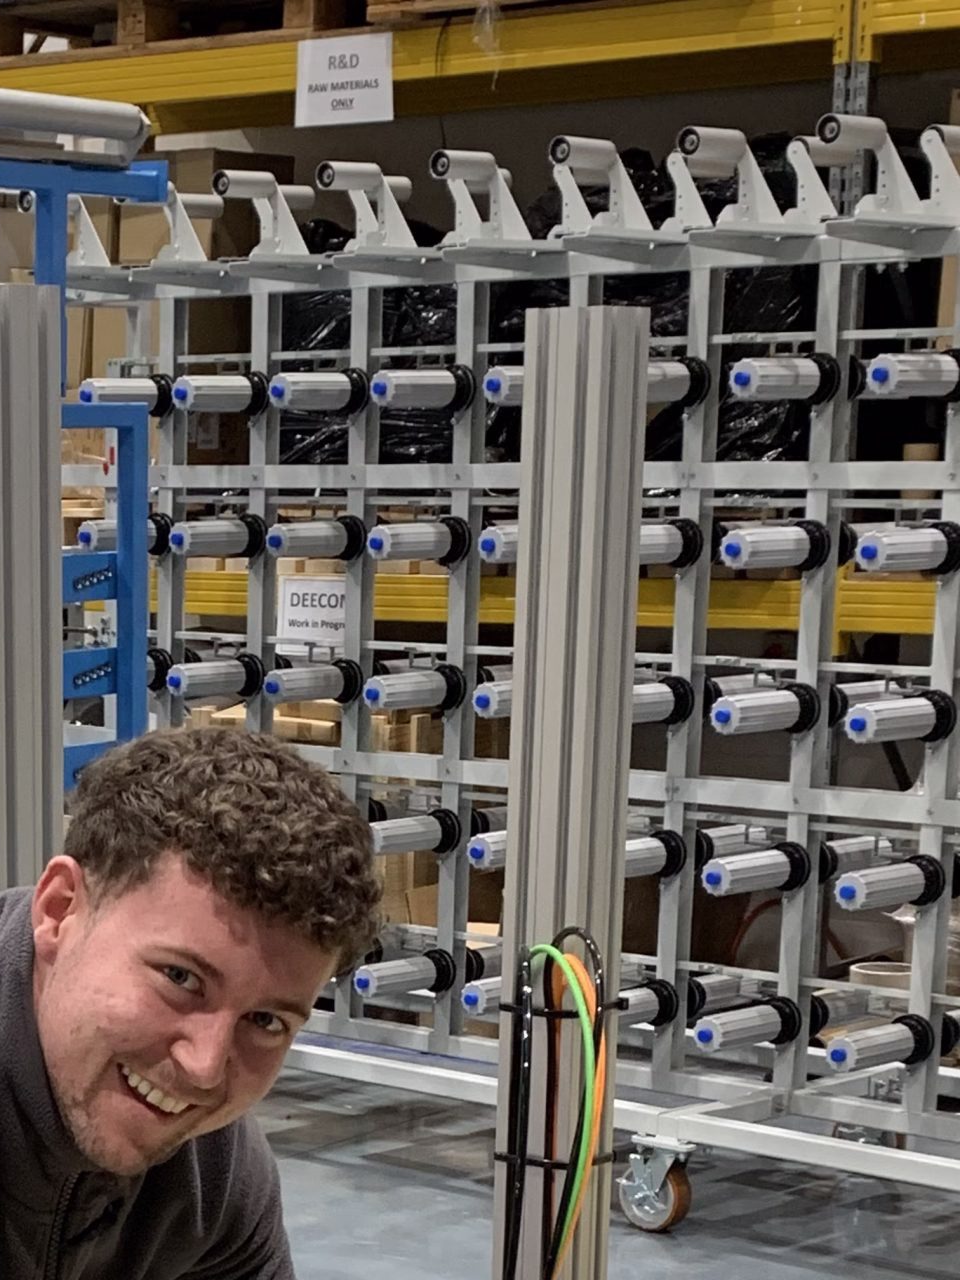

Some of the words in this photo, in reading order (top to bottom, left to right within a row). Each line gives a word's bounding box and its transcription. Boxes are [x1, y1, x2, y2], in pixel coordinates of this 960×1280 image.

[328, 54, 360, 70] R&D
[308, 83, 328, 94] RAW
[331, 78, 379, 91] MATERIALS
[331, 98, 354, 110] ONLY
[288, 619, 309, 628] Work
[311, 619, 319, 628] in
[321, 620, 346, 631] Progr
